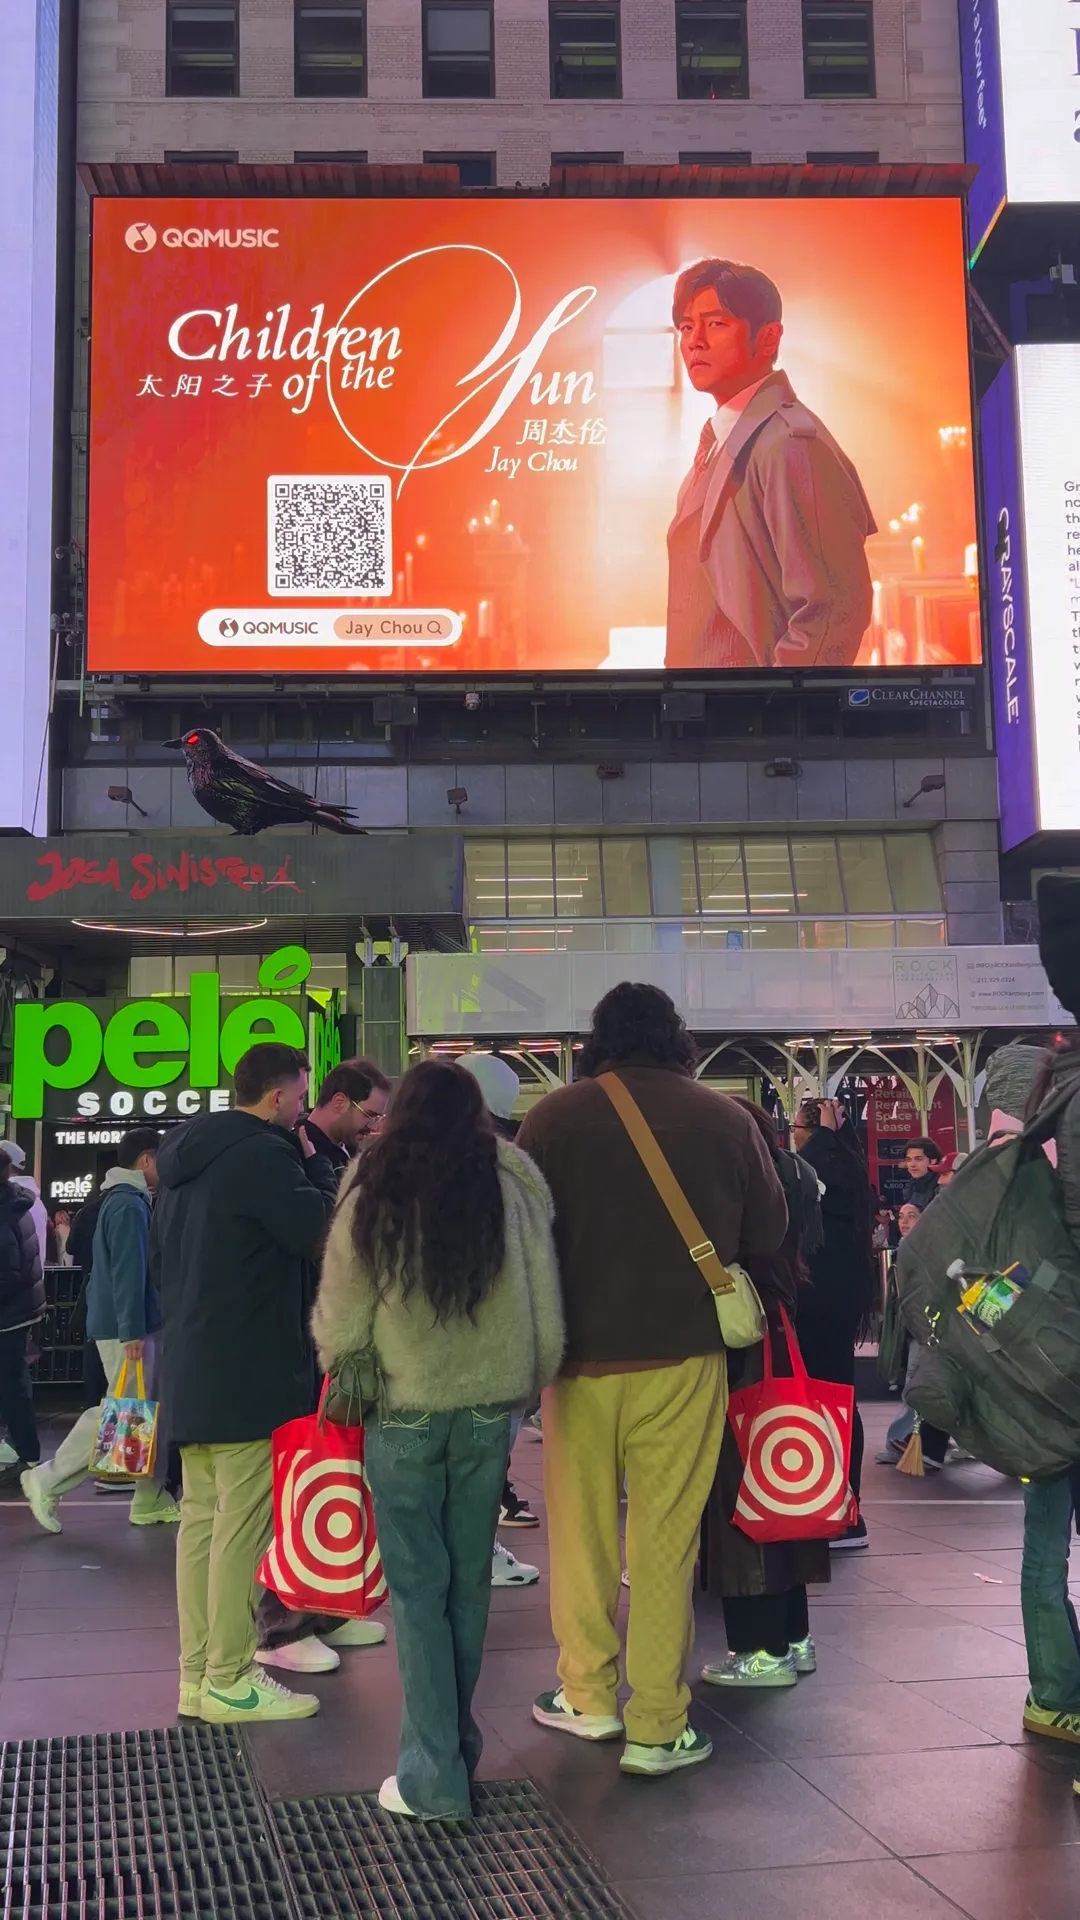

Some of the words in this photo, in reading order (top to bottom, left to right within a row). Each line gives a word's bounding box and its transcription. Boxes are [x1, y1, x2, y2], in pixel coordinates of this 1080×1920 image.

[162, 228, 280, 248] QQMUSIC
[168, 303, 402, 361] Children
[136, 374, 272, 398] 太阳之子
[282, 356, 321, 414] of
[341, 351, 395, 390] the
[515, 418, 608, 446] 周杰伦
[484, 446, 522, 479] Jay
[527, 449, 578, 472] Chou
[243, 621, 318, 635] QQMUSIC
[346, 621, 373, 637] Jay
[380, 621, 422, 634] Chou
[896, 960, 953, 972] ROCK
[77, 1090, 230, 1116] SOCCE
[876, 1123, 911, 1132] Lease
[915, 1111, 932, 1120] fr
[55, 1131, 85, 1145] THE
[88, 1131, 126, 1144] WOR
[51, 1174, 92, 1198] pelé
